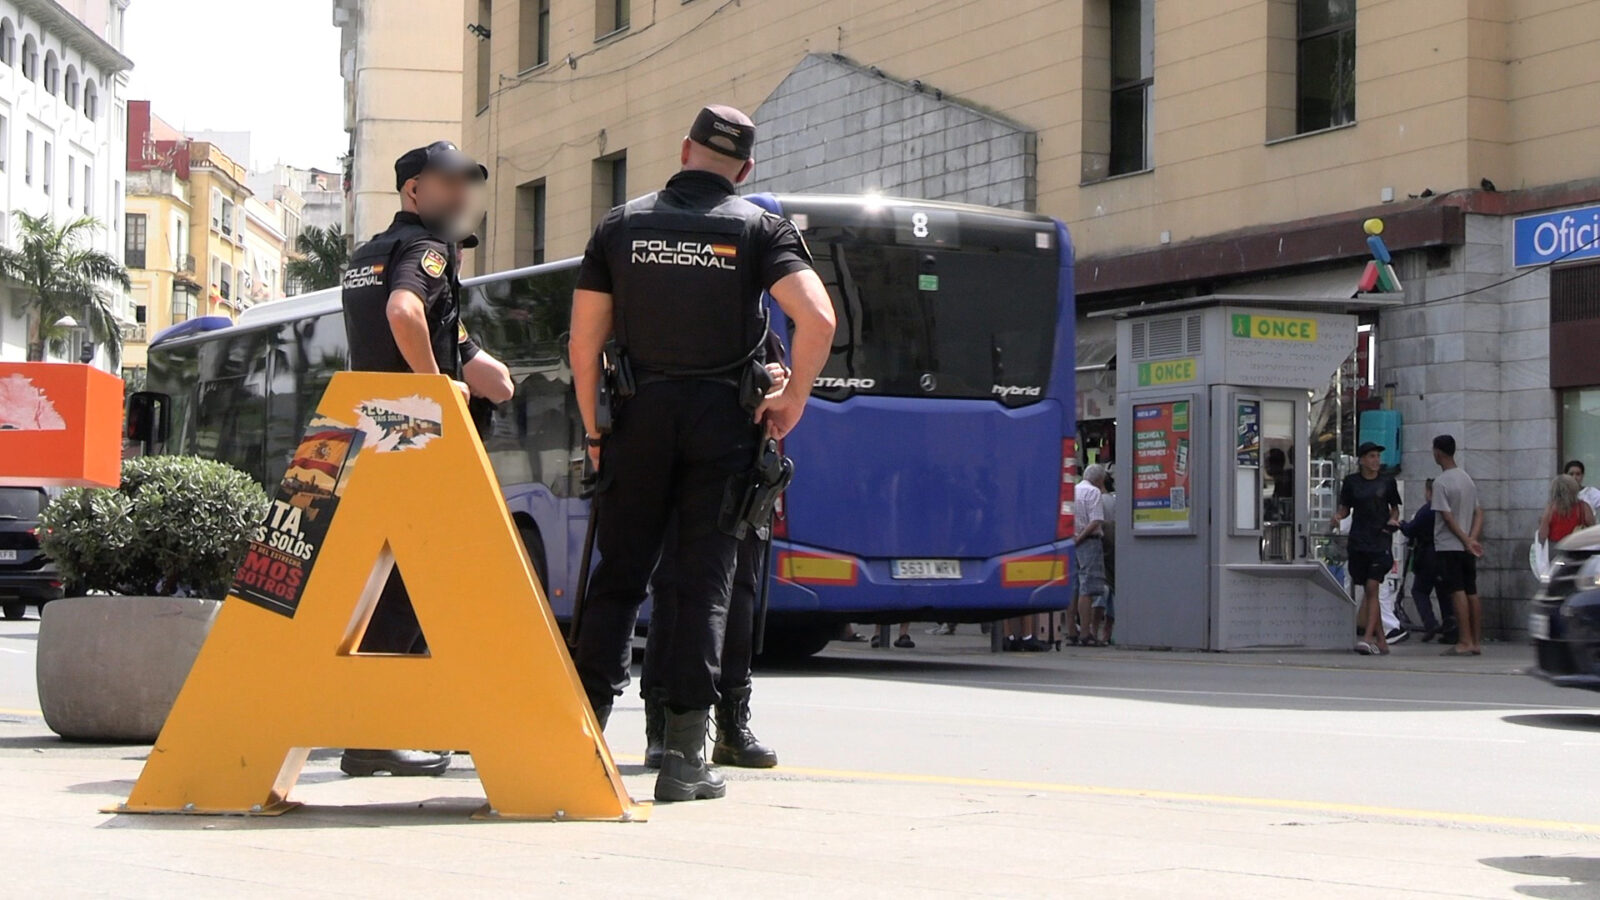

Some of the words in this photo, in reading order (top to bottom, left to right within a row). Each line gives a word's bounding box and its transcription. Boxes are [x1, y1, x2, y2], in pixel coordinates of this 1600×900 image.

[911, 212, 929, 238] 8
[631, 240, 715, 255] POLICIA
[631, 252, 736, 270] NACIONAL
[343, 275, 383, 289] NACIONAL
[1257, 319, 1311, 339] ONCE
[1155, 362, 1192, 381] ONCE
[992, 384, 1041, 397] hybrid
